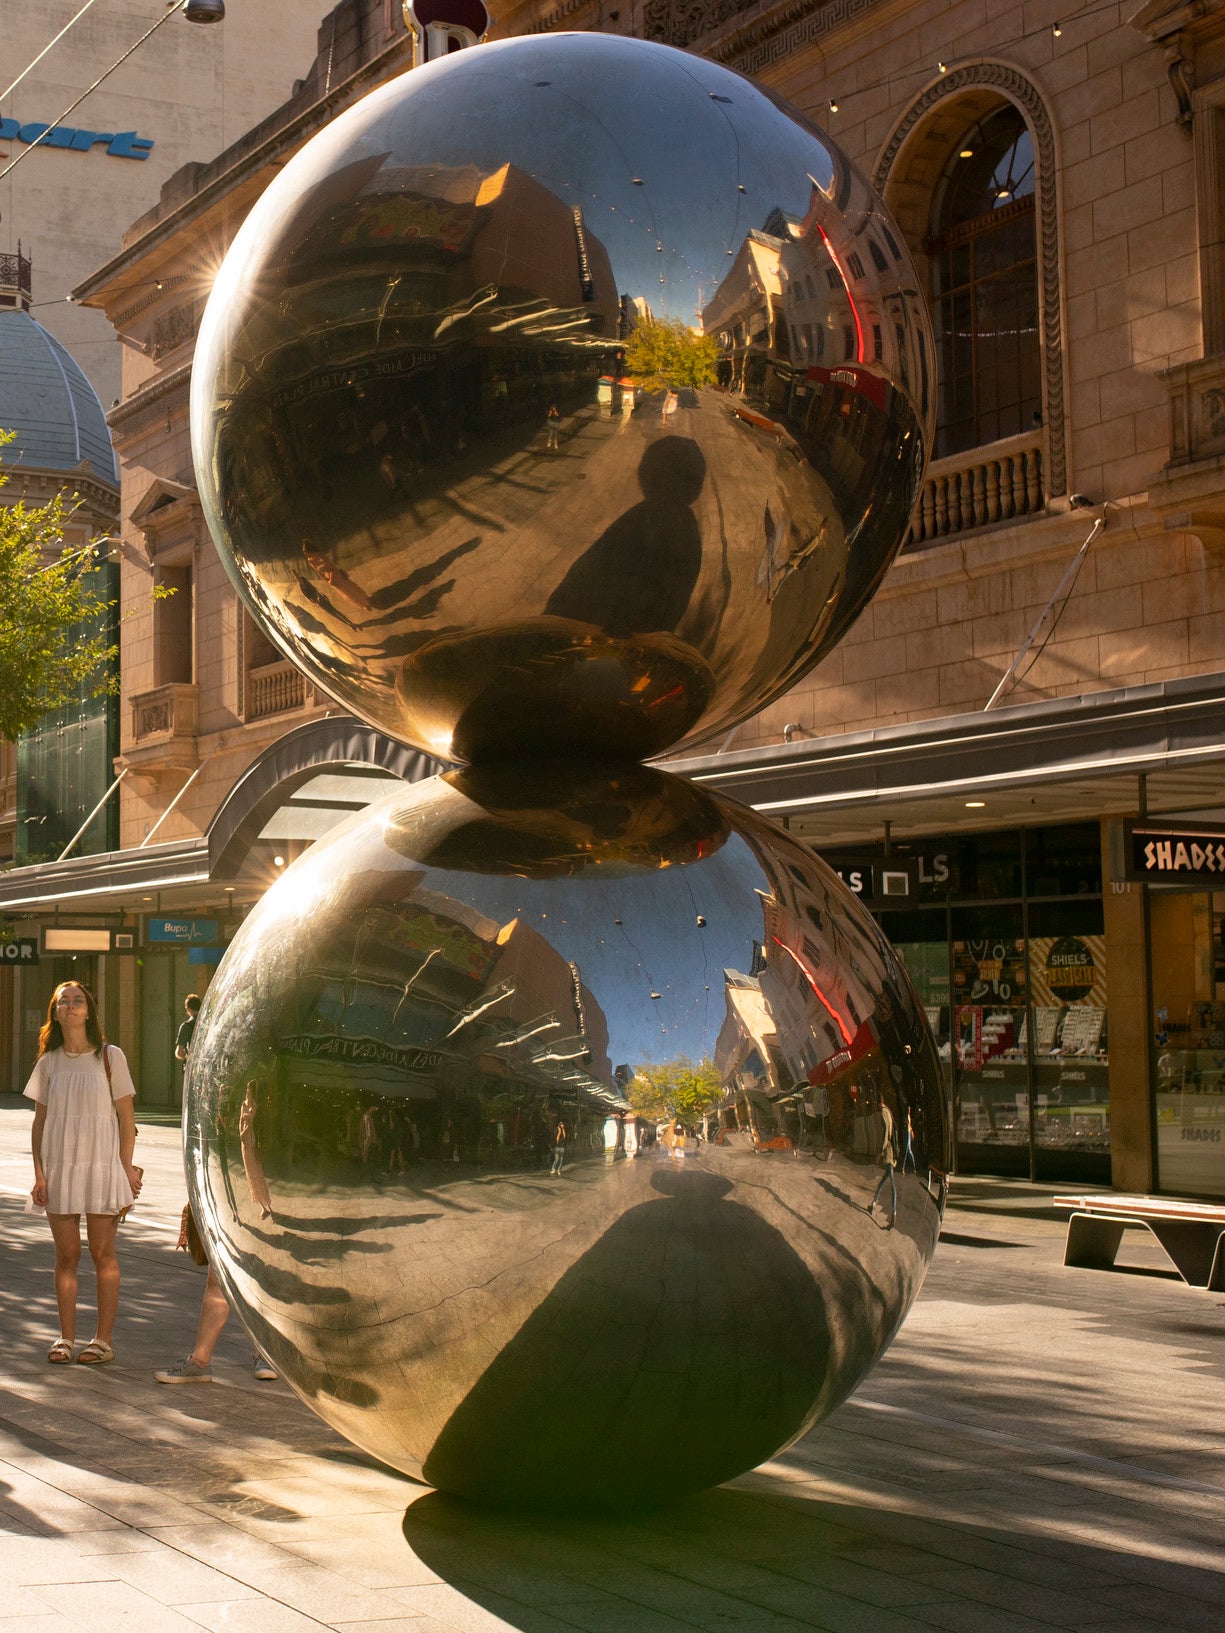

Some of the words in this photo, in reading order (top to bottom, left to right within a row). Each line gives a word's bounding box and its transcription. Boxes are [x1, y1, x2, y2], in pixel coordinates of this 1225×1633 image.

[1143, 840, 1225, 873] SHADES
[163, 922, 188, 935] Bupa
[1050, 953, 1088, 965] SHIELS
[1074, 967, 1097, 983] SALE
[1180, 1127, 1222, 1143] SHADES
